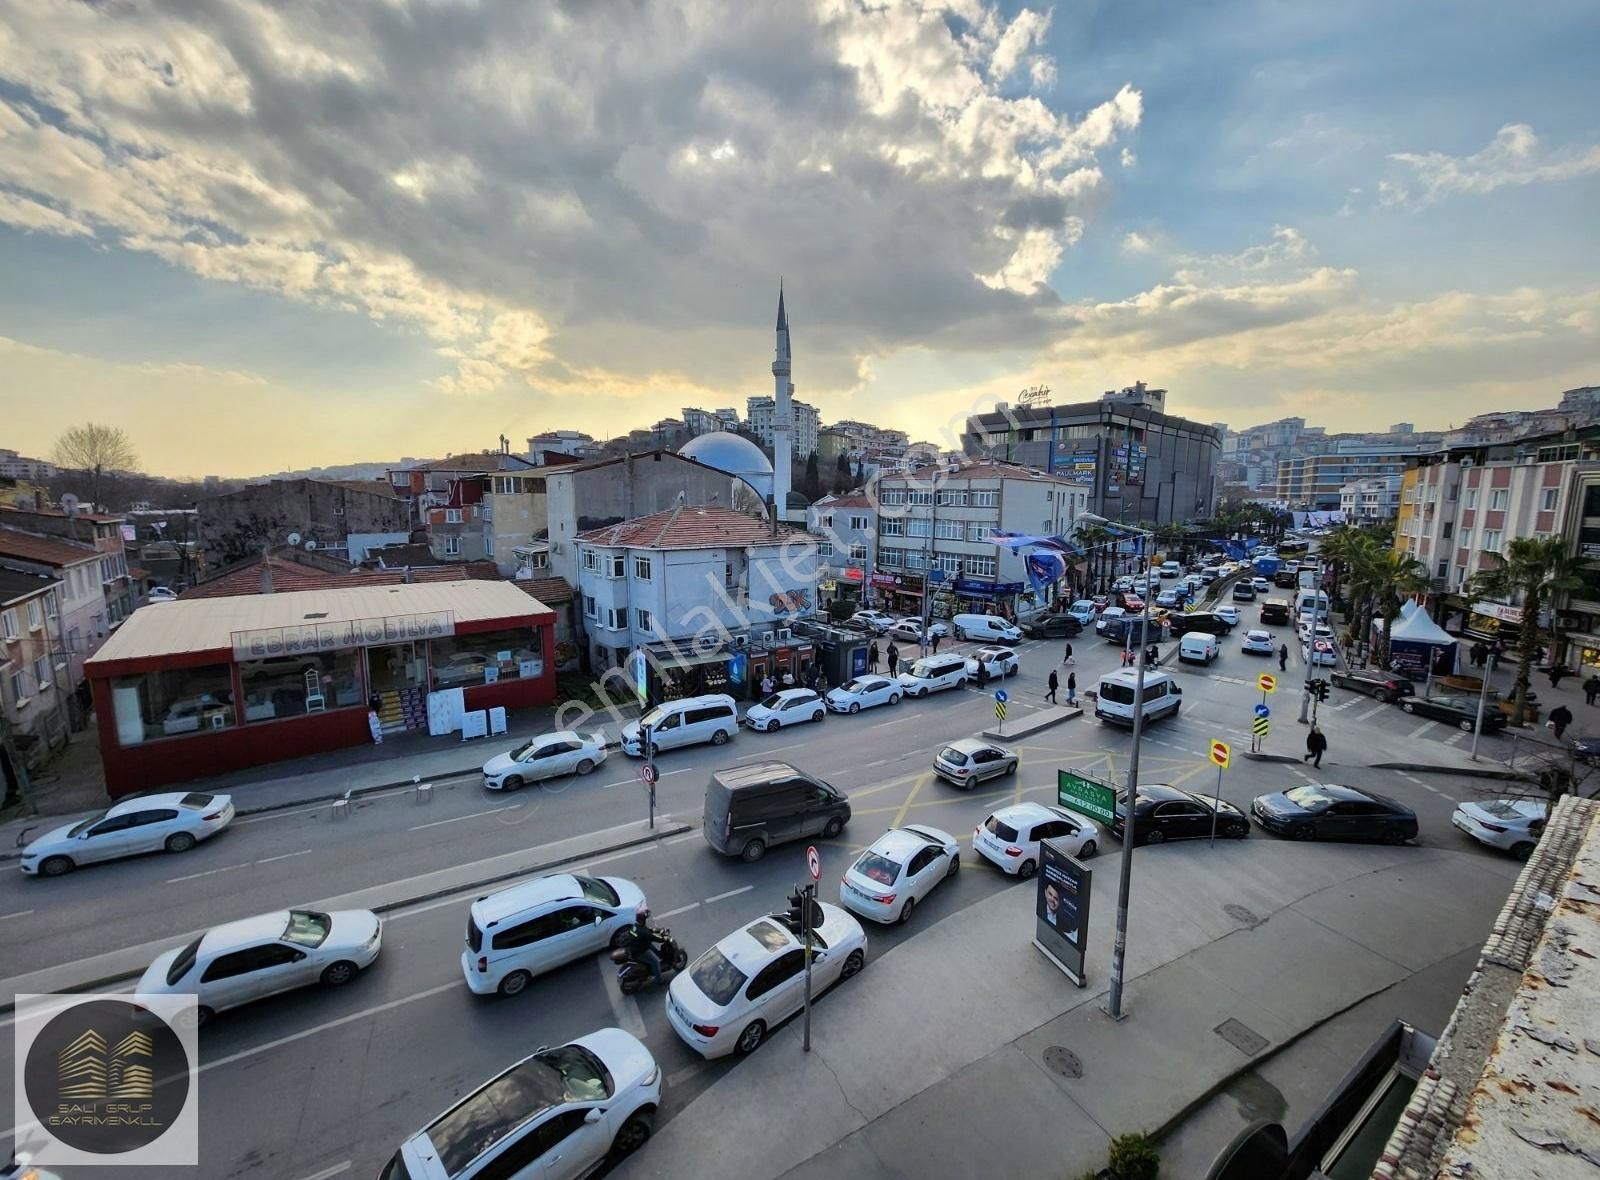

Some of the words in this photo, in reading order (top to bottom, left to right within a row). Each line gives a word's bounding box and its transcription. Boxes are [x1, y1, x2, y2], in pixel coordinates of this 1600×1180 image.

[250, 630, 335, 655] EBRAR
[343, 618, 443, 645] MOBİLYA
[1066, 782, 1107, 802] AVRASYA
